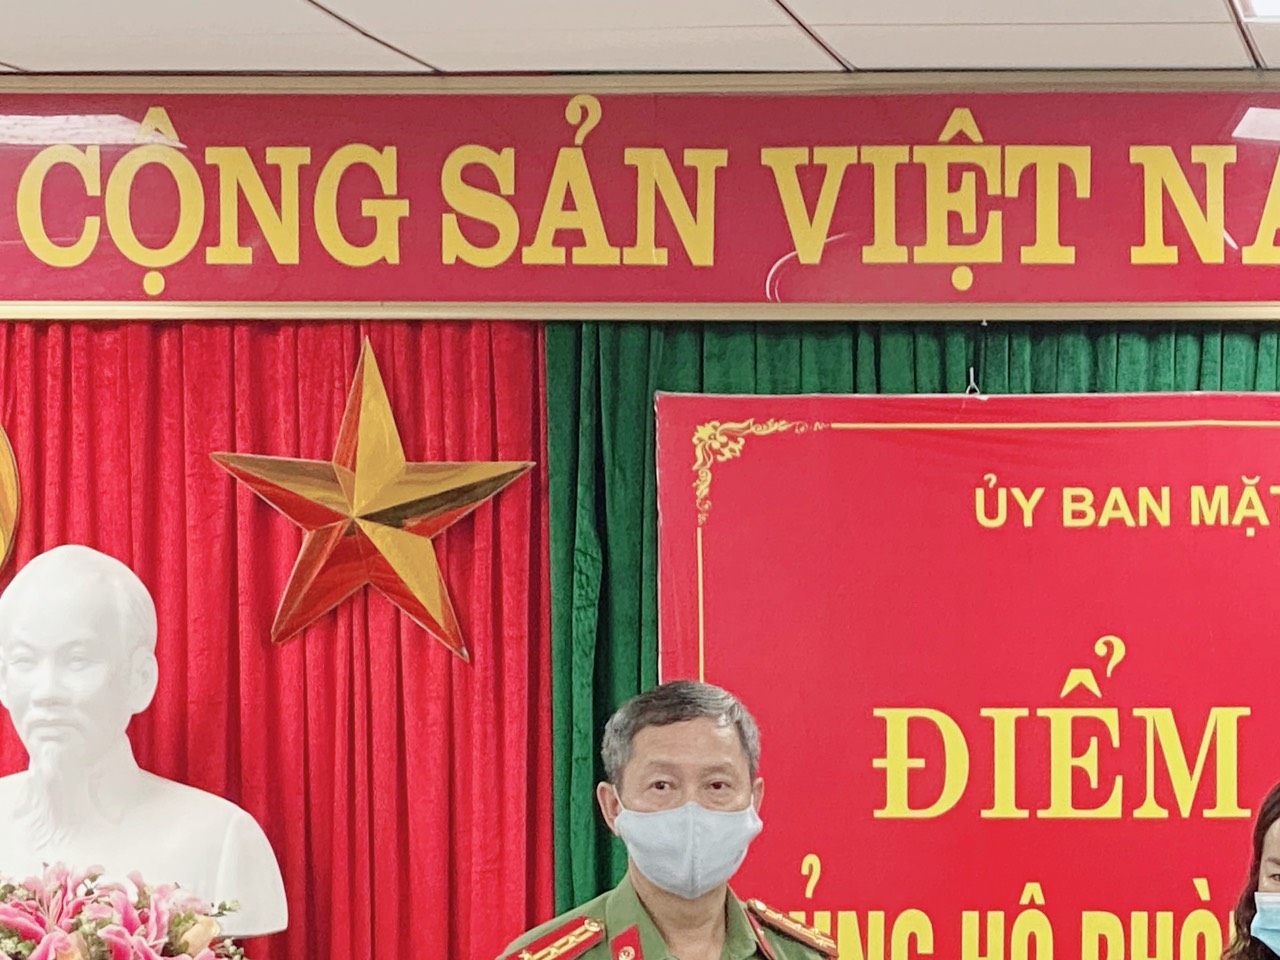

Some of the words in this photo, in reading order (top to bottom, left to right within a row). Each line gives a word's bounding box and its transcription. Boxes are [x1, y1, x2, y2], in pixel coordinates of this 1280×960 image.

[17, 106, 409, 296] CỘNG
[441, 94, 728, 266] SẢN
[761, 107, 1091, 292] VIỆT
[975, 473, 1045, 528] ỦY
[1062, 485, 1171, 528] BAN
[872, 635, 1252, 819] ĐIỂM
